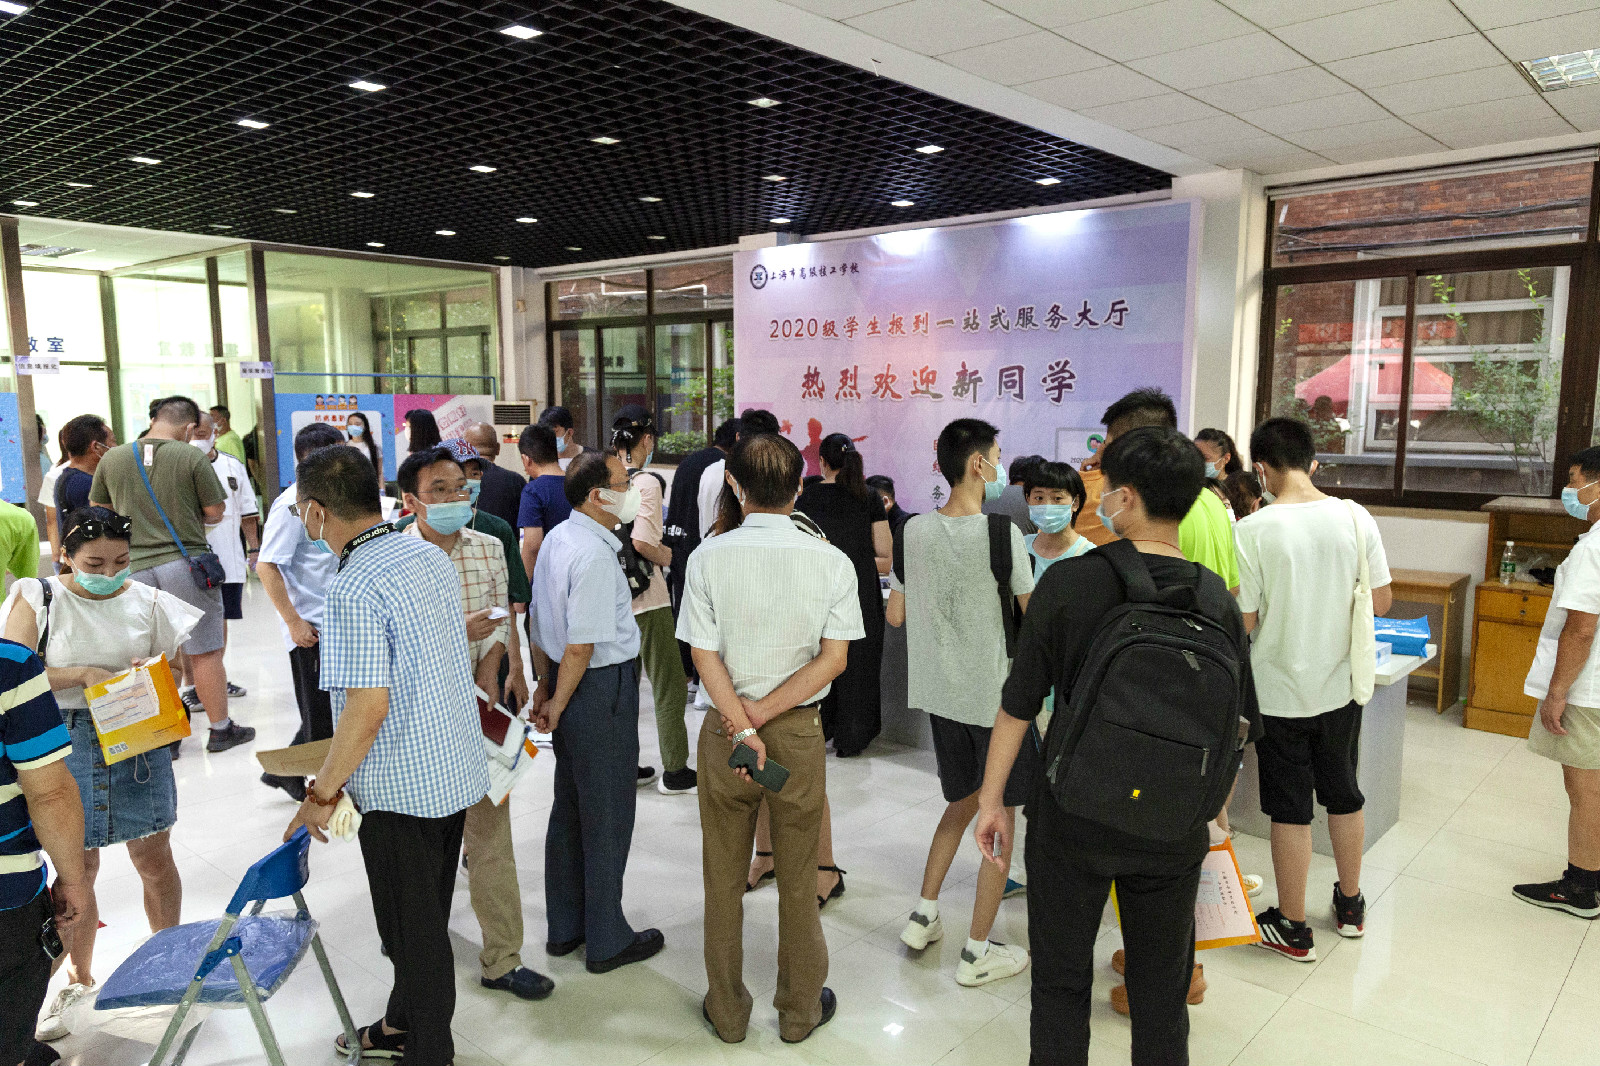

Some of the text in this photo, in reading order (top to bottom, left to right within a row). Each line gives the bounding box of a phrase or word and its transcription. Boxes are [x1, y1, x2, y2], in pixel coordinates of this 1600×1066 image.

[768, 299, 1129, 339] 2020级学生报到一站式服务大厅
[800, 359, 1077, 404] 热烈欢迎新同学
[352, 525, 390, 546] Supreme
